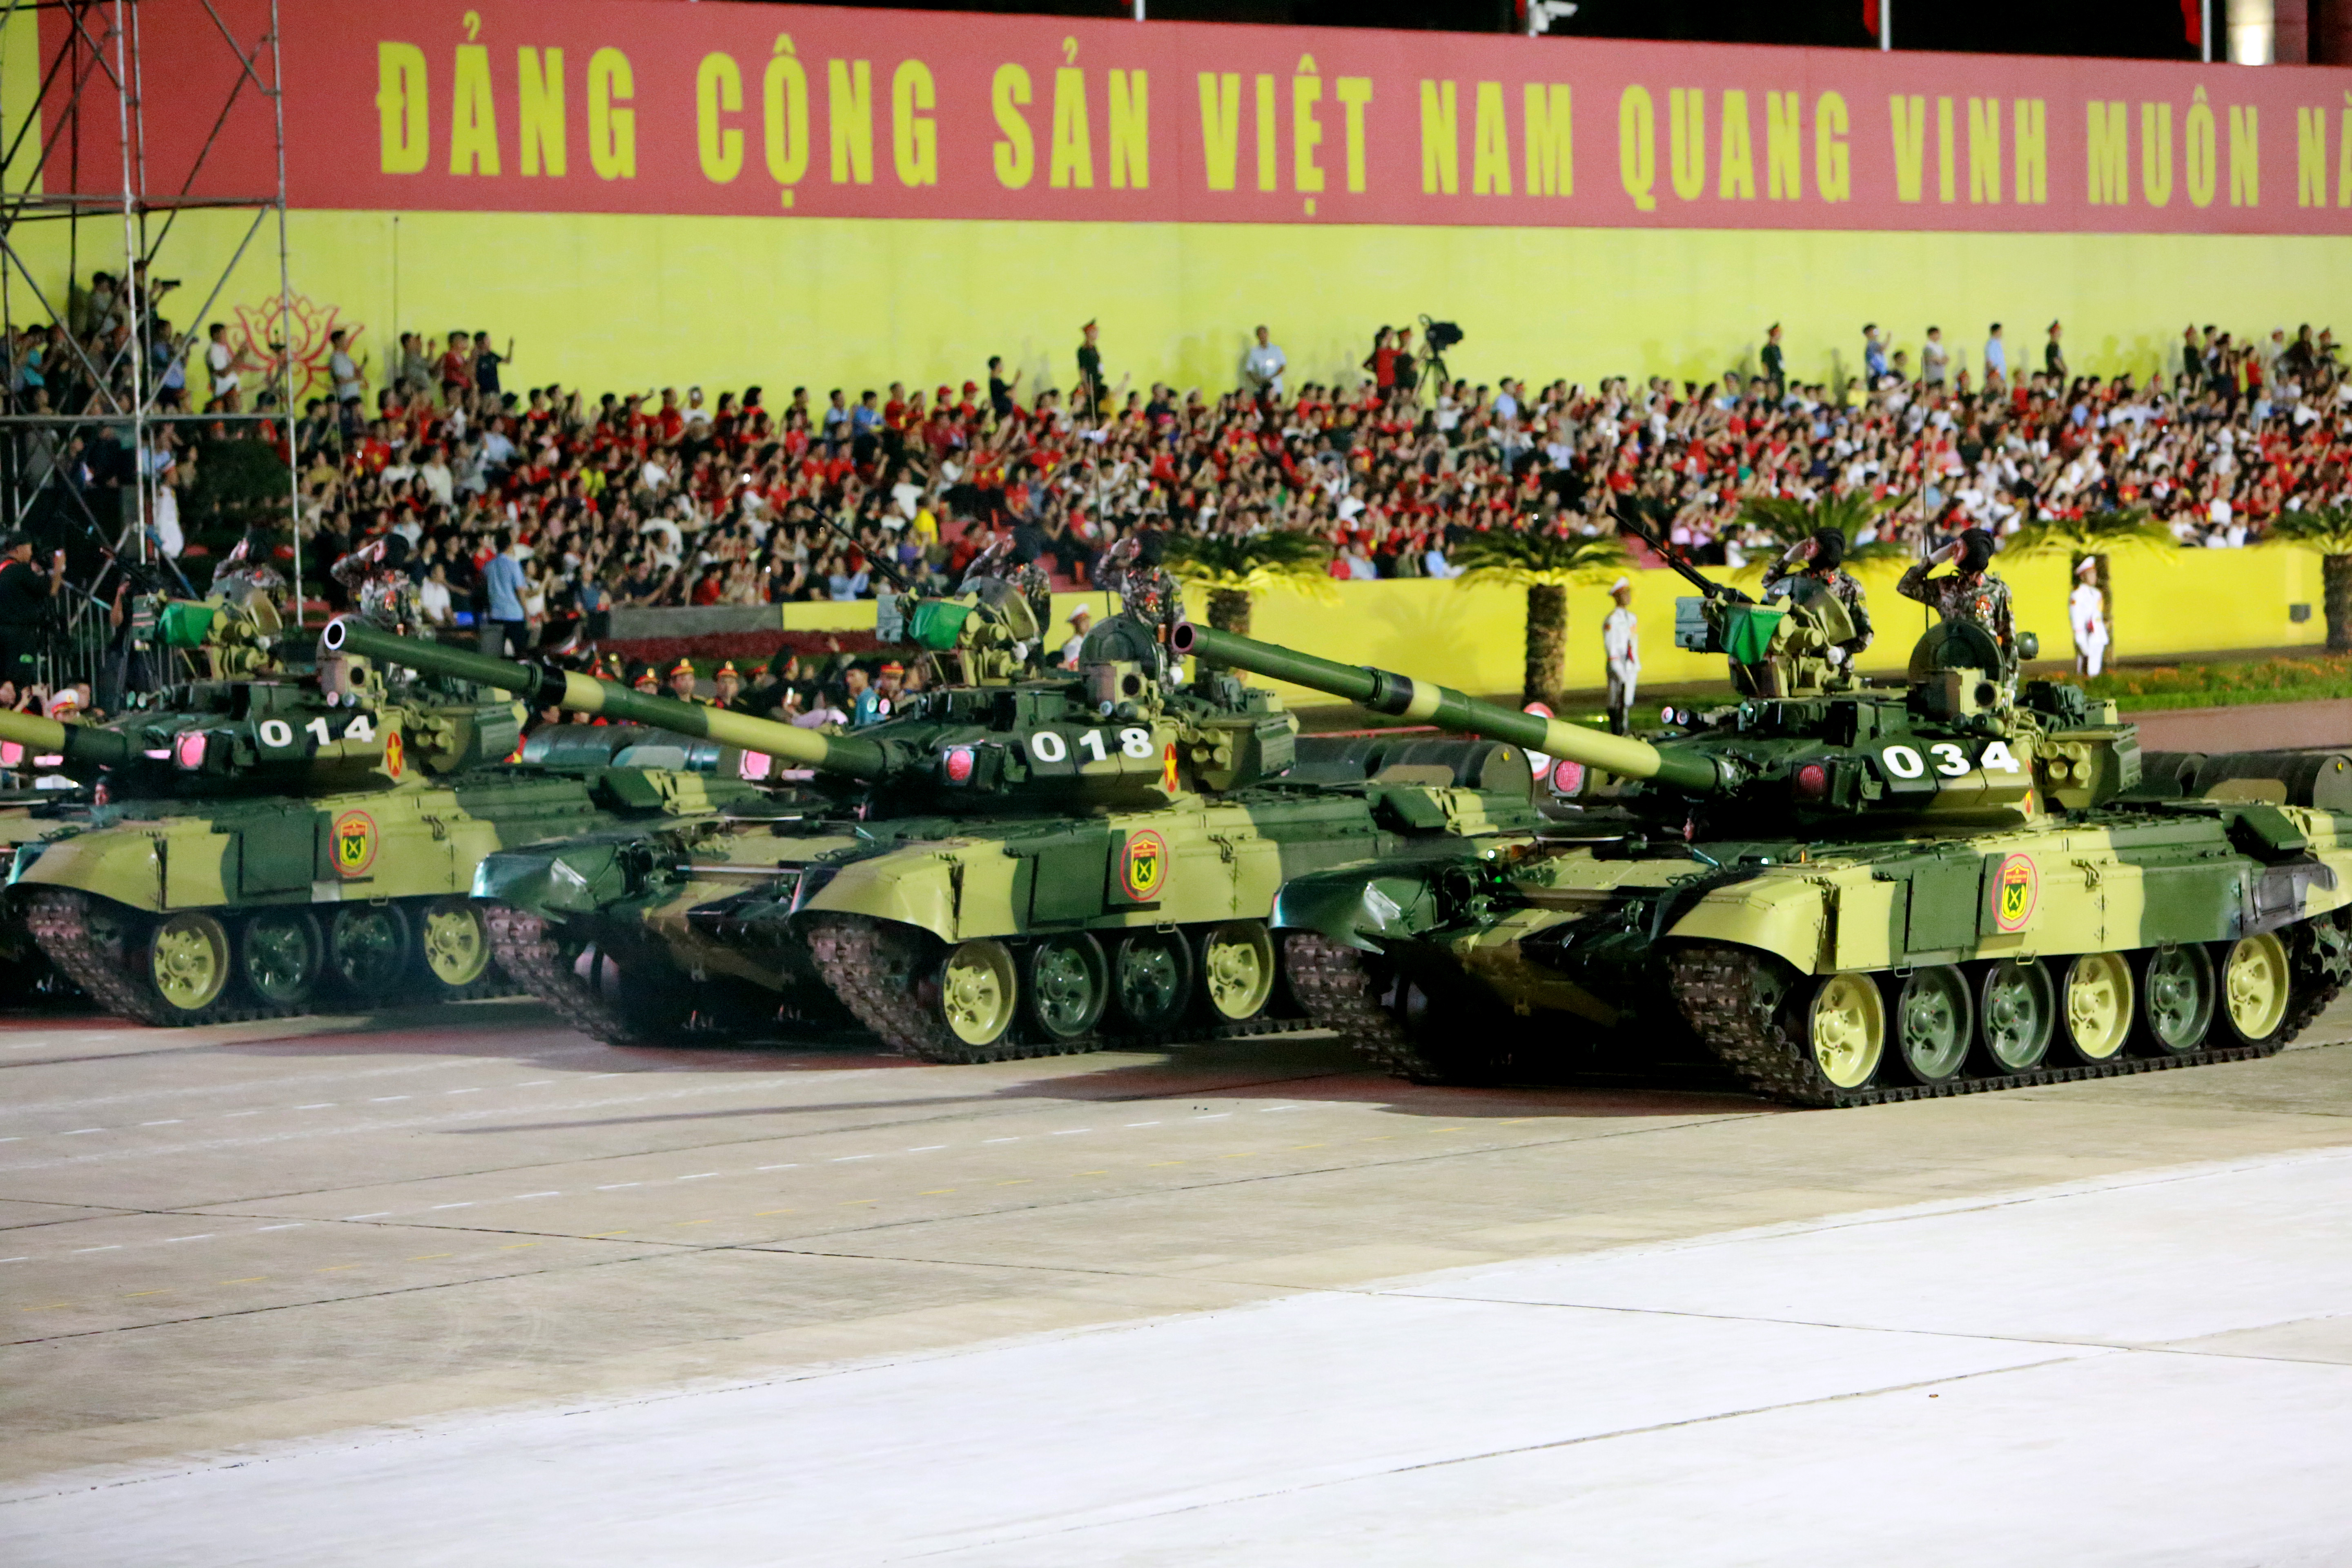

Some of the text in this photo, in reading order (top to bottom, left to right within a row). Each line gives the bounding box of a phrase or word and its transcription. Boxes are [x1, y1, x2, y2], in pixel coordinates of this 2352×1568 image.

[376, 11, 637, 181] ĐẢNG
[696, 33, 938, 208] CỘNG
[992, 36, 1149, 189] SẢN
[1197, 57, 1373, 216] VIỆT
[1419, 79, 1574, 198] NAM
[1618, 84, 1851, 211] QUANG
[1890, 94, 2048, 204] VINH
[2087, 85, 2259, 208] MUÔN
[260, 715, 376, 747] 014
[1031, 728, 1154, 762] 018
[1882, 741, 2021, 779] 034
